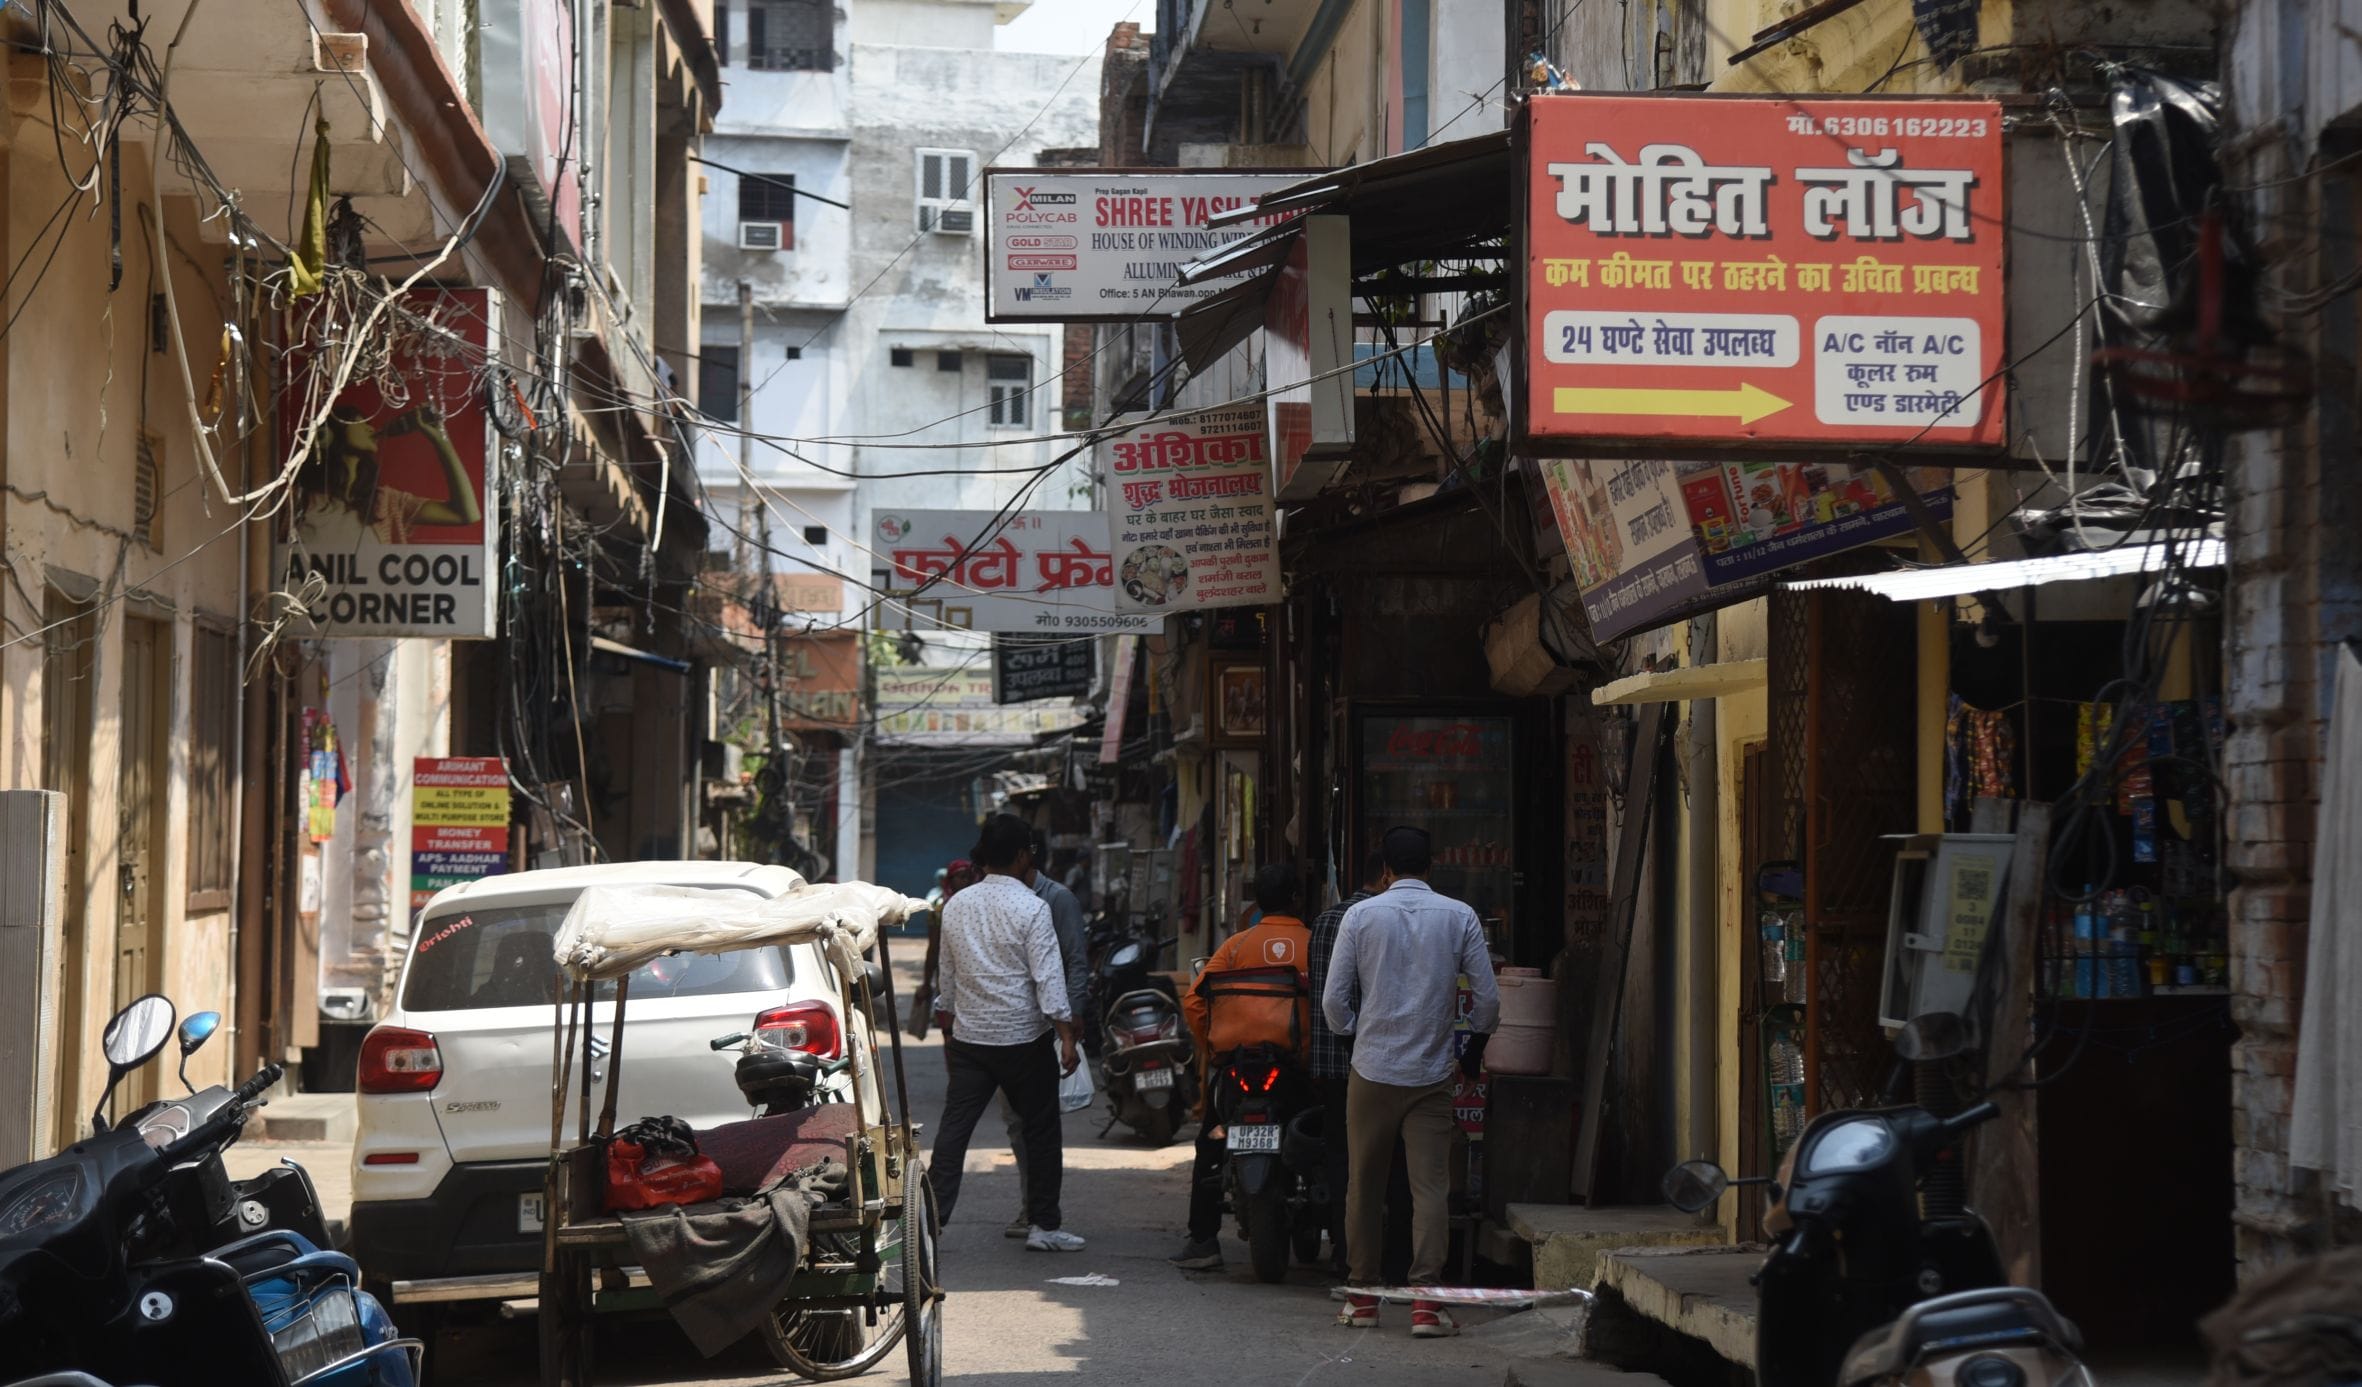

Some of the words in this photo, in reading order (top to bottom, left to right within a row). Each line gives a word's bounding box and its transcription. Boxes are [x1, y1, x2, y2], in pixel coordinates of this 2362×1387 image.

[1548, 142, 1774, 240] मोहित
[1795, 148, 1977, 242] लॉज
[1006, 213, 1077, 223] POLYCAB
[1096, 196, 1173, 227] SHREE
[1011, 238, 1041, 247] GOLD
[1092, 232, 1135, 250] HOUSE
[1138, 232, 1155, 249] OF
[1158, 232, 1217, 249] WINDING
[1543, 258, 1591, 288] कम
[1598, 251, 1673, 289] कीमत
[1681, 261, 1715, 291] पर
[1721, 254, 1788, 292] ठहरने
[1795, 262, 1832, 293] का
[1842, 256, 1904, 294] उचित
[1912, 264, 1980, 295] प्रबन्ध
[1014, 287, 1032, 301] VM
[1100, 288, 1130, 299] Office:
[1133, 288, 1139, 298] 5
[1141, 289, 1155, 298] AN
[1562, 325, 1592, 354] 24
[1600, 319, 1646, 357] घण्टे
[1652, 320, 1695, 357] सेवा
[1702, 327, 1776, 358] उपलब्ध
[1823, 333, 1865, 353] A/C
[1873, 330, 1914, 354] नॉन
[1922, 334, 1965, 355] A/C
[1845, 363, 1897, 388] कूलर
[1844, 393, 1888, 412] एण्ड
[1113, 431, 1265, 473] अंशिका
[1122, 480, 1162, 510] शुद्ध
[1168, 472, 1262, 500] भोजनालय
[1729, 466, 1749, 524] Fortune
[1126, 514, 1141, 526] घर
[1146, 509, 1158, 524] के
[1161, 510, 1186, 524] बाहर
[1190, 509, 1206, 521] घर
[1210, 505, 1235, 519] जैसा
[1238, 504, 1264, 518] स्वाद
[281, 554, 367, 585] ANIL
[378, 554, 480, 586] COOL
[892, 535, 1023, 590] फोटो
[1716, 555, 1735, 567] पता
[307, 593, 456, 625] CORNER
[436, 790, 450, 798] ALL
[453, 790, 472, 798] TYPE
[437, 828, 481, 837] MONEY
[427, 839, 492, 849] TRANSFER
[449, 853, 500, 863] AADHAR
[430, 864, 488, 873] PAYMENT
[1239, 1126, 1274, 1137] UP32R
